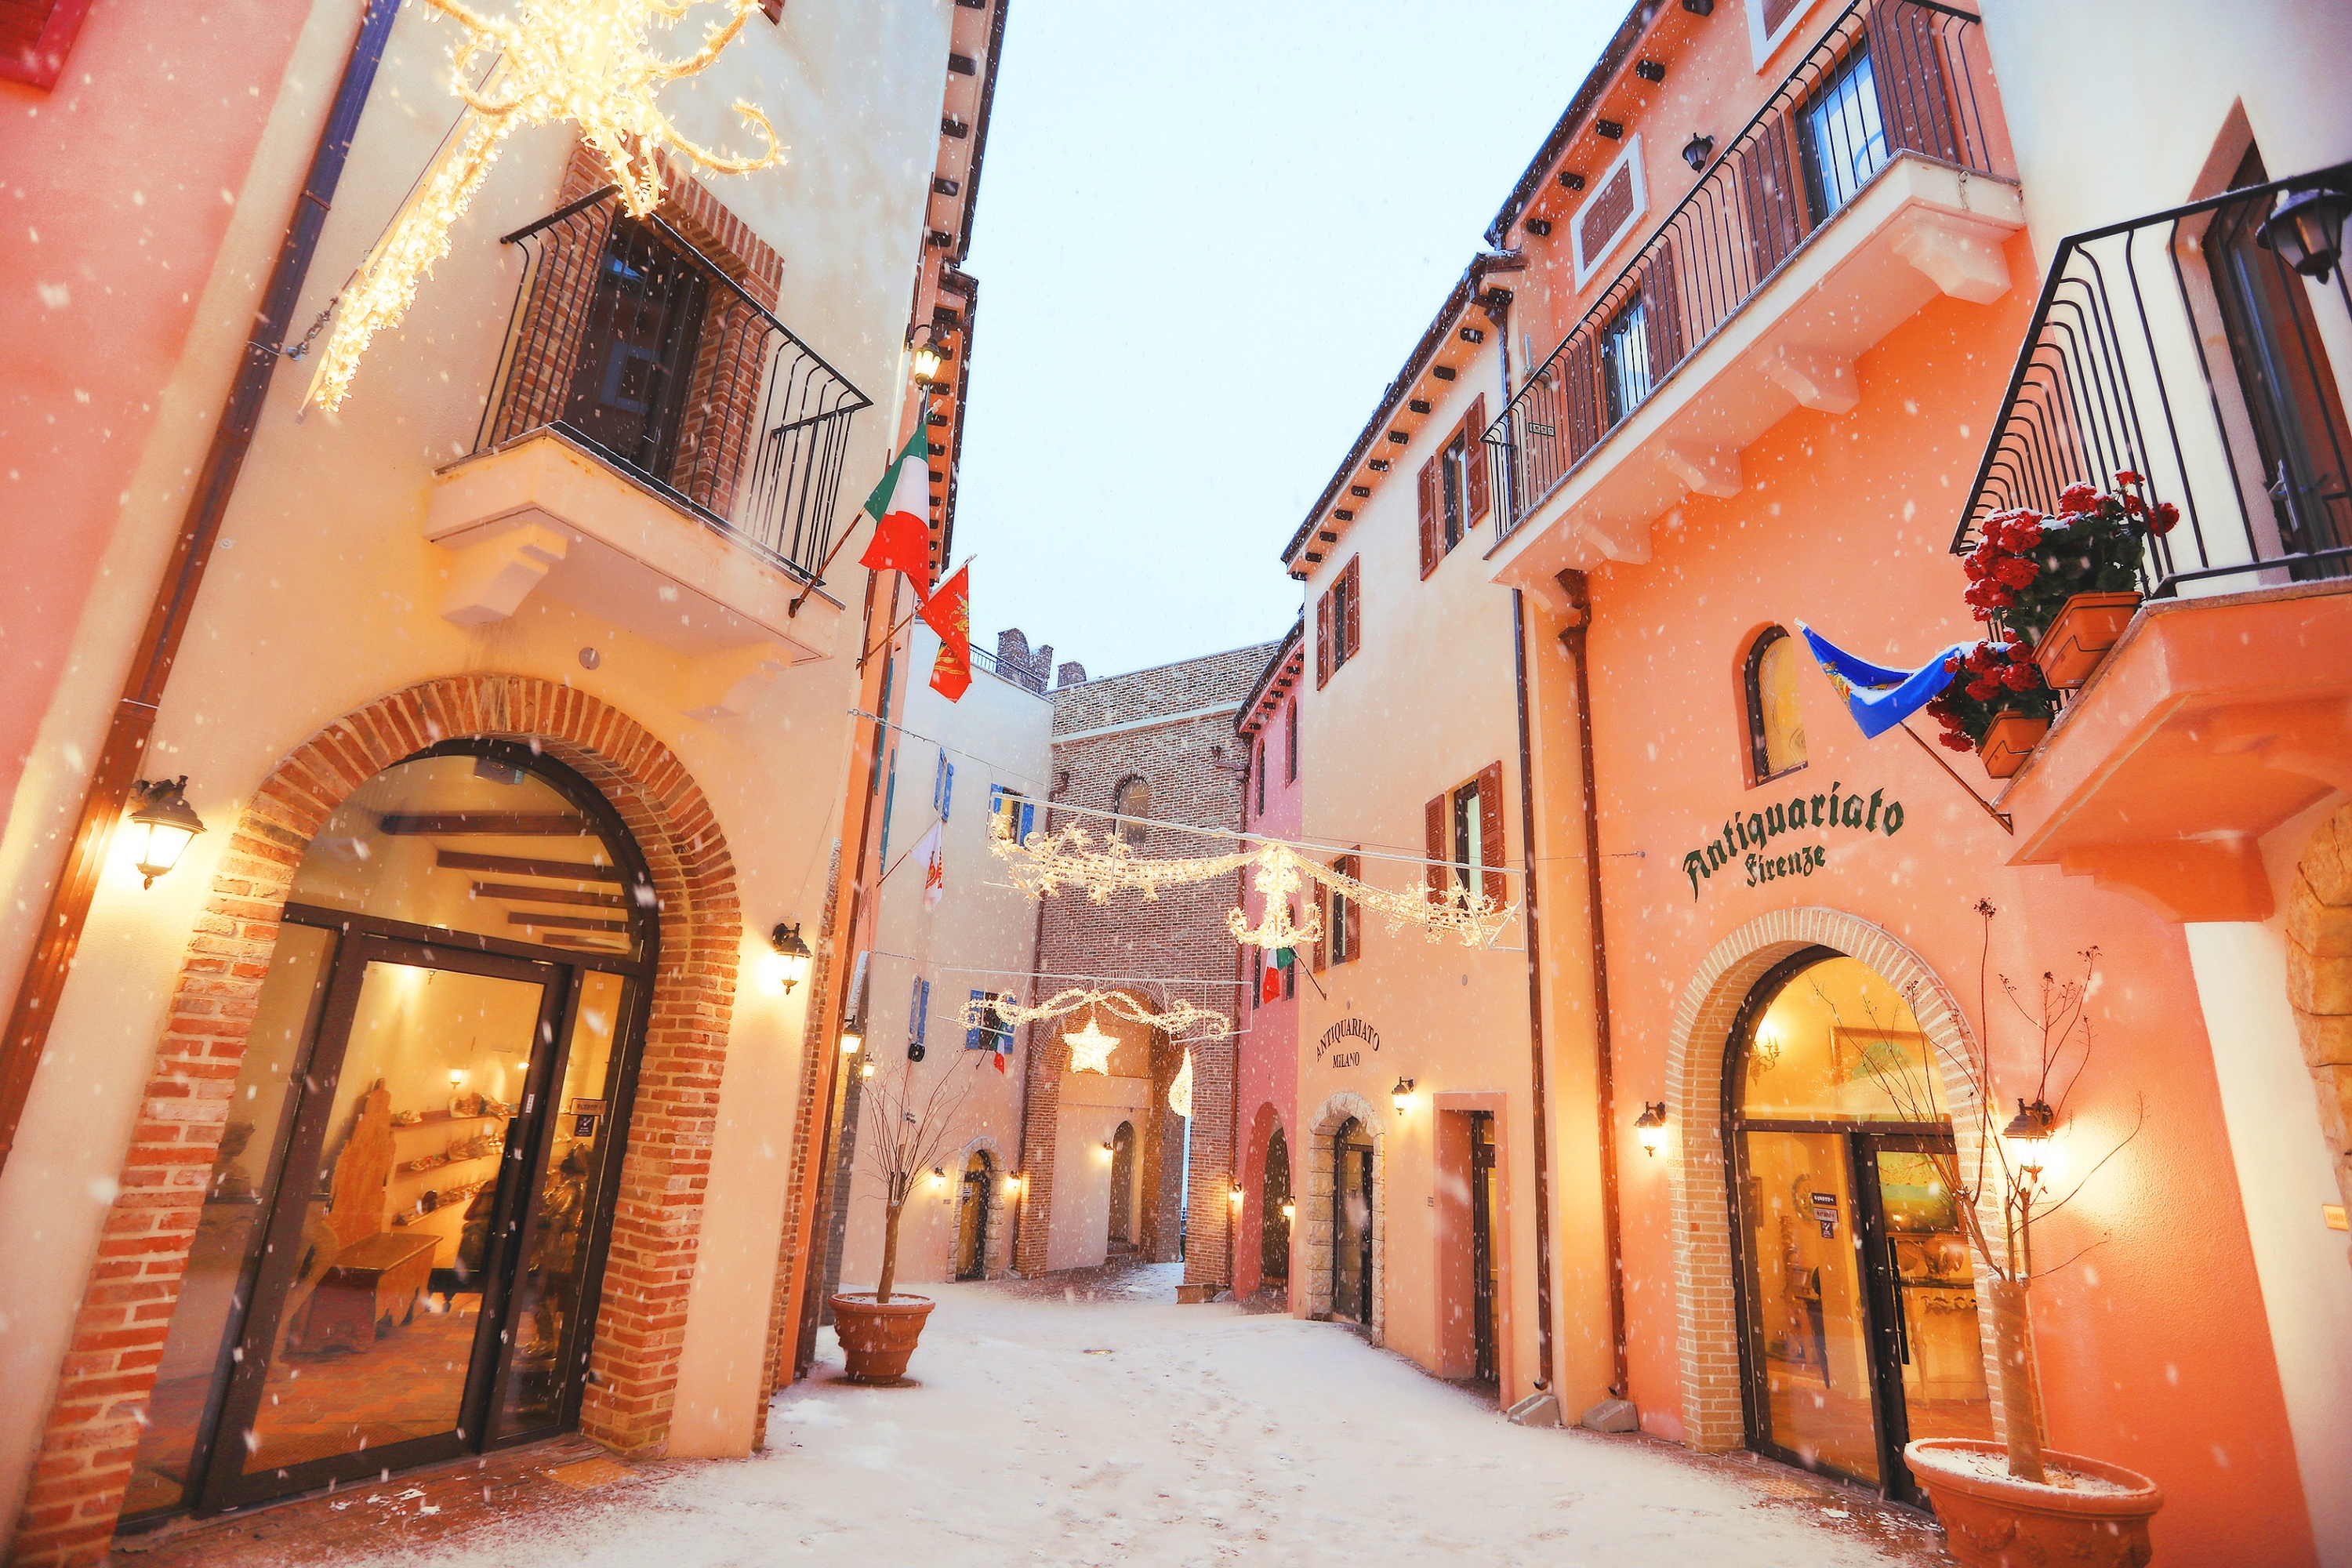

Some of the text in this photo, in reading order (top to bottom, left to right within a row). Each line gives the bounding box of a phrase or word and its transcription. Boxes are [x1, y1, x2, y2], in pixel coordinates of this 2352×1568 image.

[1682, 781, 1904, 903] Antiquariato
[1744, 844, 1826, 887] Firenze
[1316, 1018, 1380, 1062] ANTIQUARIATO
[1333, 1051, 1360, 1069] MILANO
